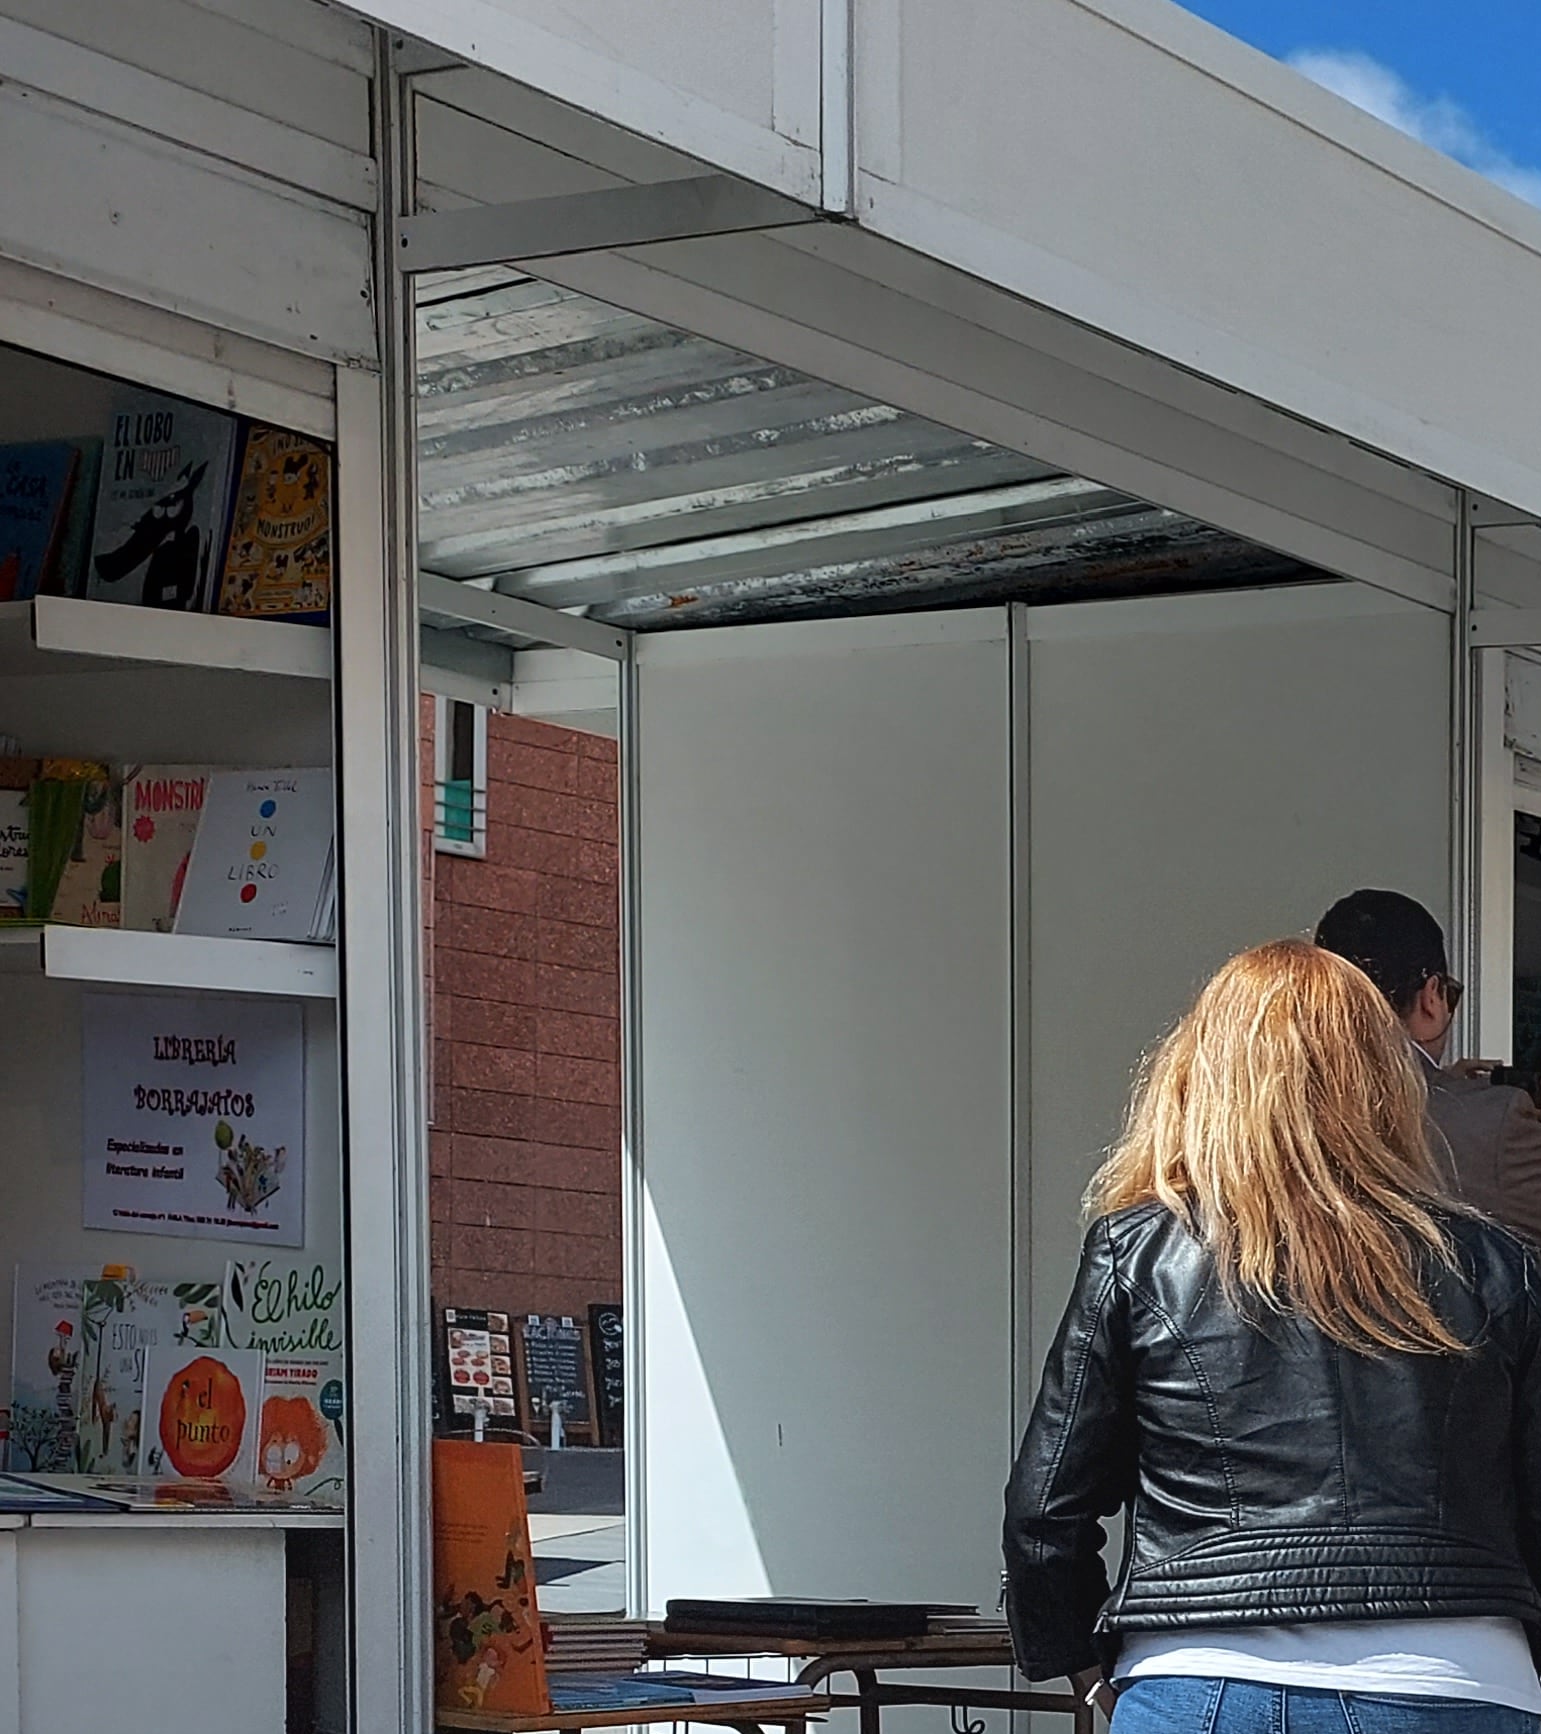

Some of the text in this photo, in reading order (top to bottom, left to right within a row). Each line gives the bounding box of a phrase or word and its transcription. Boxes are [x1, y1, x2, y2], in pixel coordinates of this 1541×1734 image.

[115, 411, 173, 446] EL LOBO
[115, 451, 134, 480] EN
[134, 777, 205, 811] MONSTR
[250, 825, 276, 837] UN
[228, 862, 278, 881] LIBRO
[153, 1034, 237, 1067] LIBRERÍA
[134, 1084, 255, 1118] BORRAJATOS
[287, 1264, 341, 1312] hilo
[249, 1318, 343, 1356] invisible
[197, 1377, 213, 1410] el
[176, 1418, 230, 1449] punto
